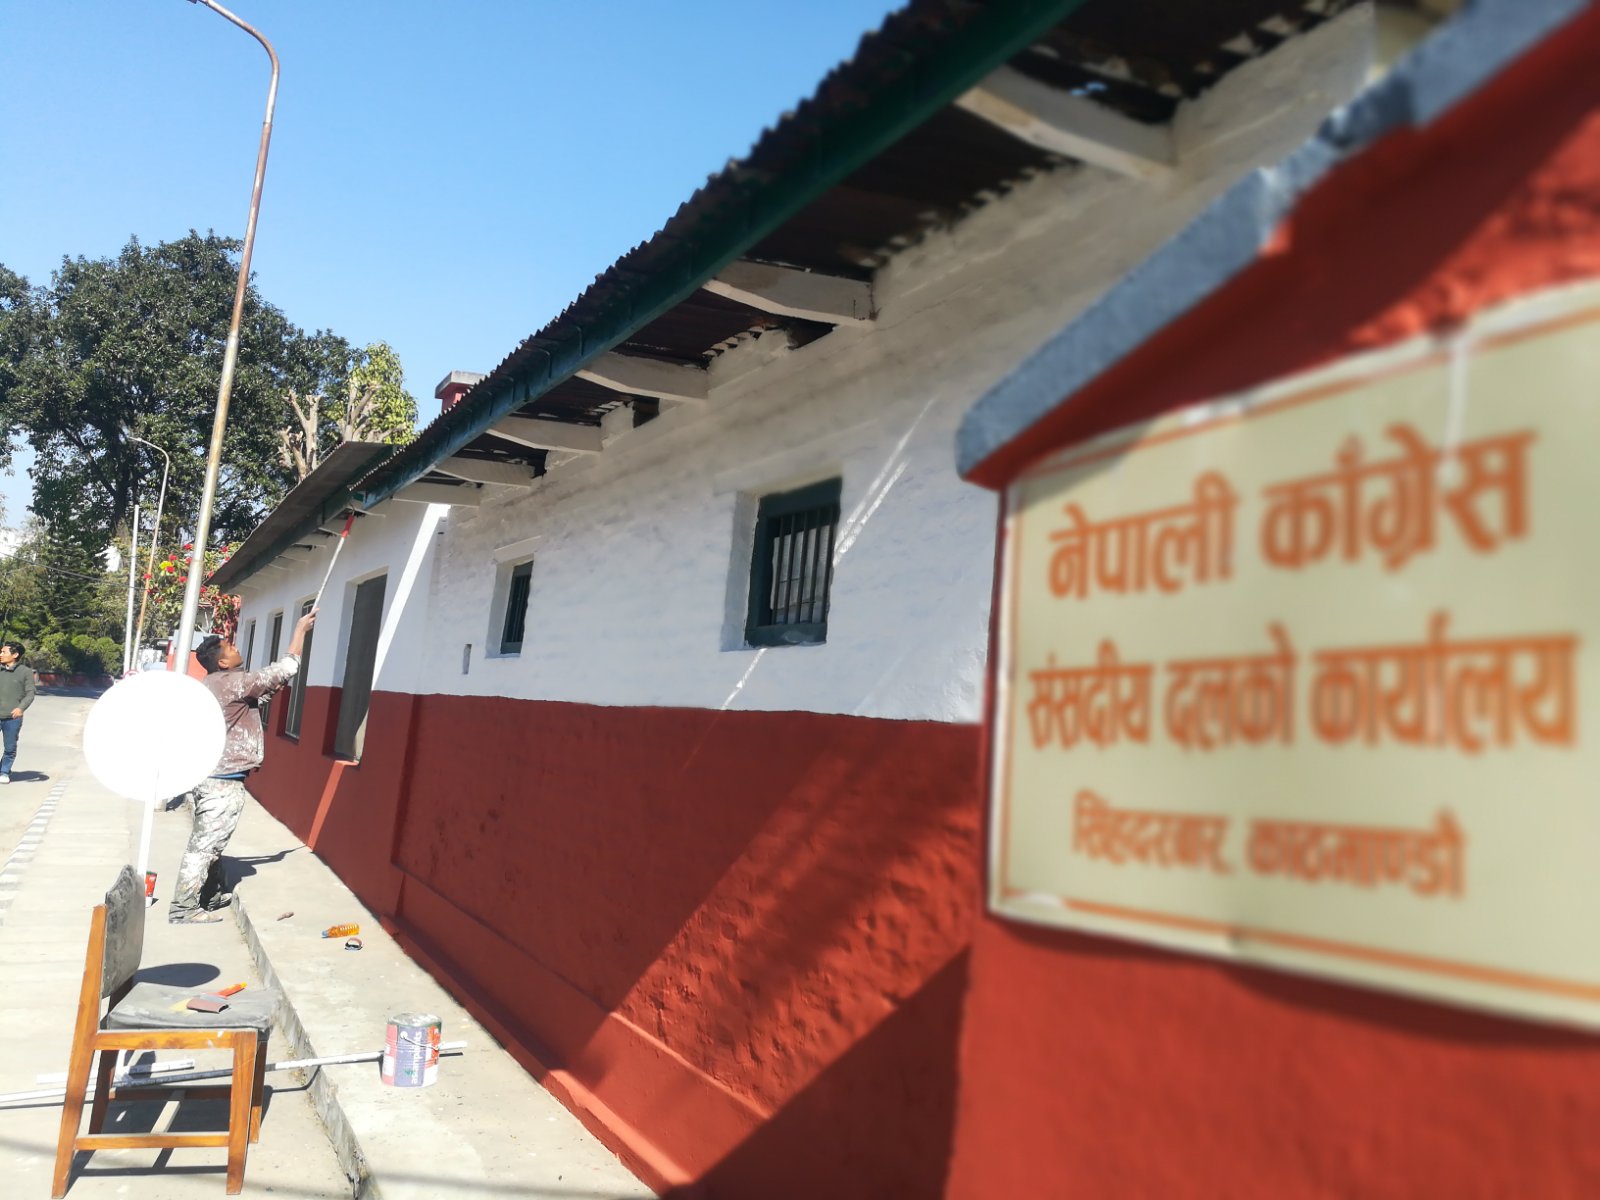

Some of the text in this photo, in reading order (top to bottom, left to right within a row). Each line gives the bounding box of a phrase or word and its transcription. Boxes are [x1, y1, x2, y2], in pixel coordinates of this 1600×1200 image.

[1048, 471, 1238, 599] नेपाली
[1027, 611, 1580, 753] संसदीय दलको कार्यालय
